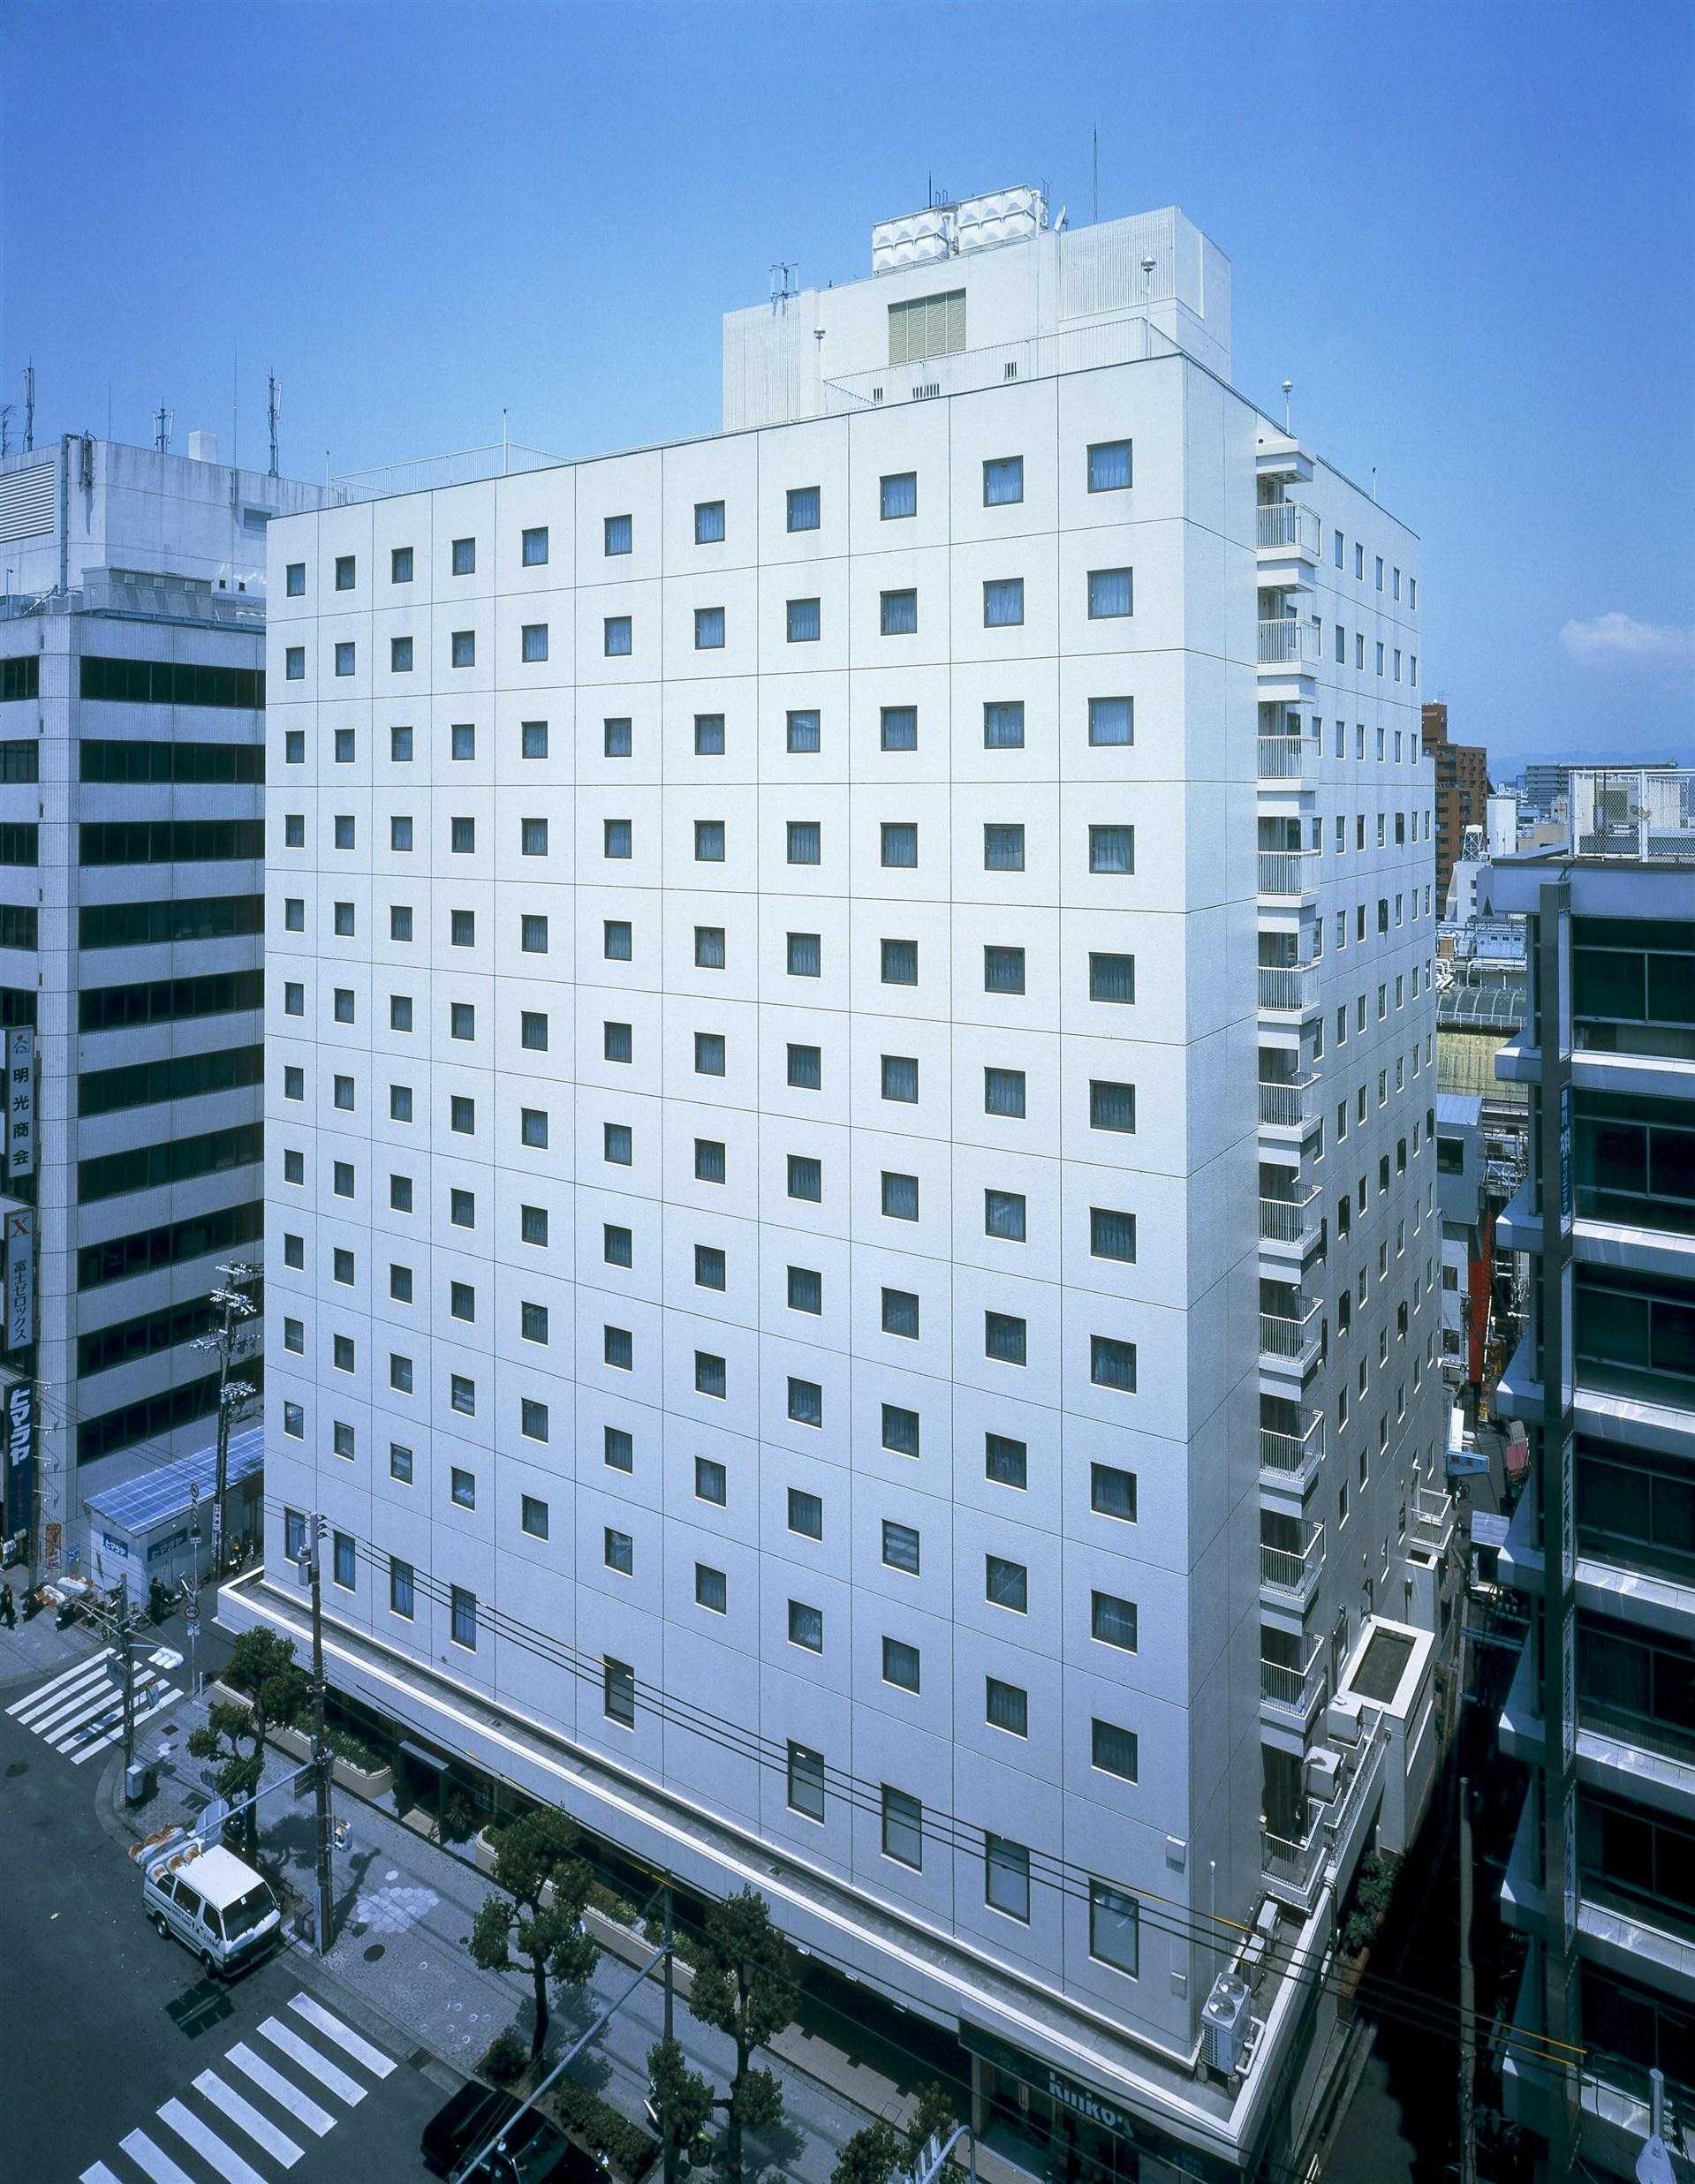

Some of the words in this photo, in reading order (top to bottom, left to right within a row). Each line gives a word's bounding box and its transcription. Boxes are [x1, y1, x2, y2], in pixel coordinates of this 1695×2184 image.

[13, 1067, 30, 1166] 明光商会
[13, 1259, 27, 1342] 富士ゼロックス
[10, 1388, 32, 1467] ヒマラヤ
[1048, 2071, 1134, 2138] kinko's
